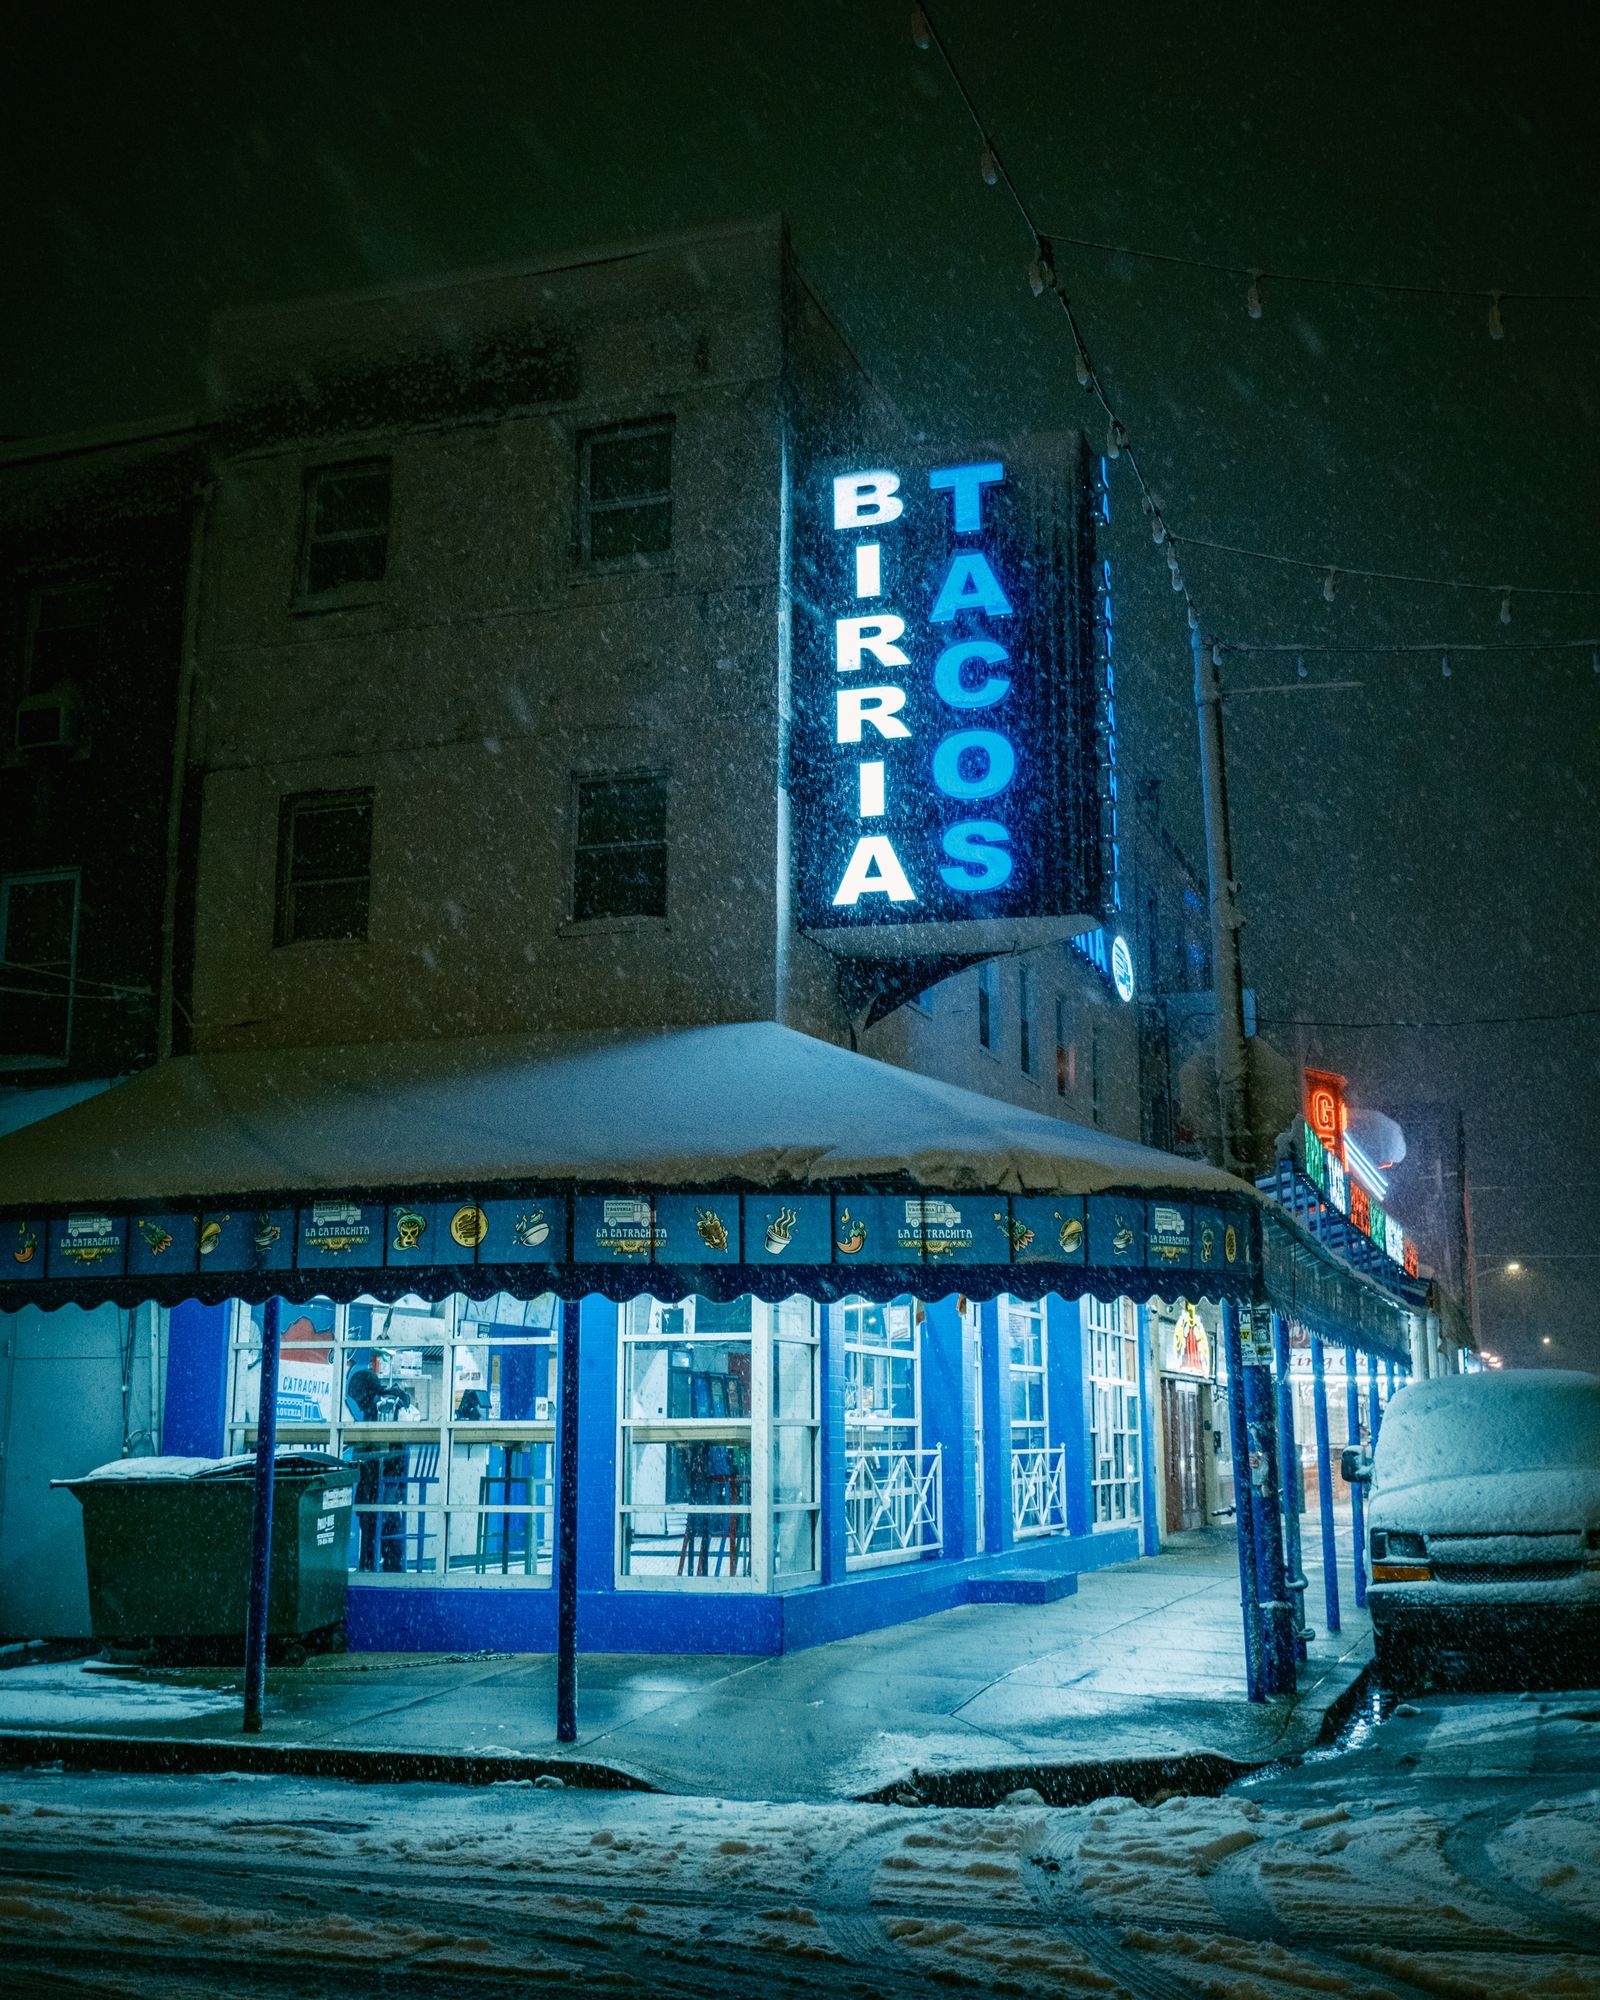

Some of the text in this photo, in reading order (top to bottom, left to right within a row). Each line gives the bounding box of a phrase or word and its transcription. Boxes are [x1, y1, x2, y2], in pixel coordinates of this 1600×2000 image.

[929, 462, 1015, 893] TACOS
[832, 470, 917, 907] BIRRIA
[305, 1226, 370, 1237] LA CATRACHITA
[596, 1228, 608, 1238] LA
[898, 1229, 911, 1239] LA
[60, 1236, 120, 1248] LA CATRACHITA
[282, 1376, 330, 1394] CATRACHITA
